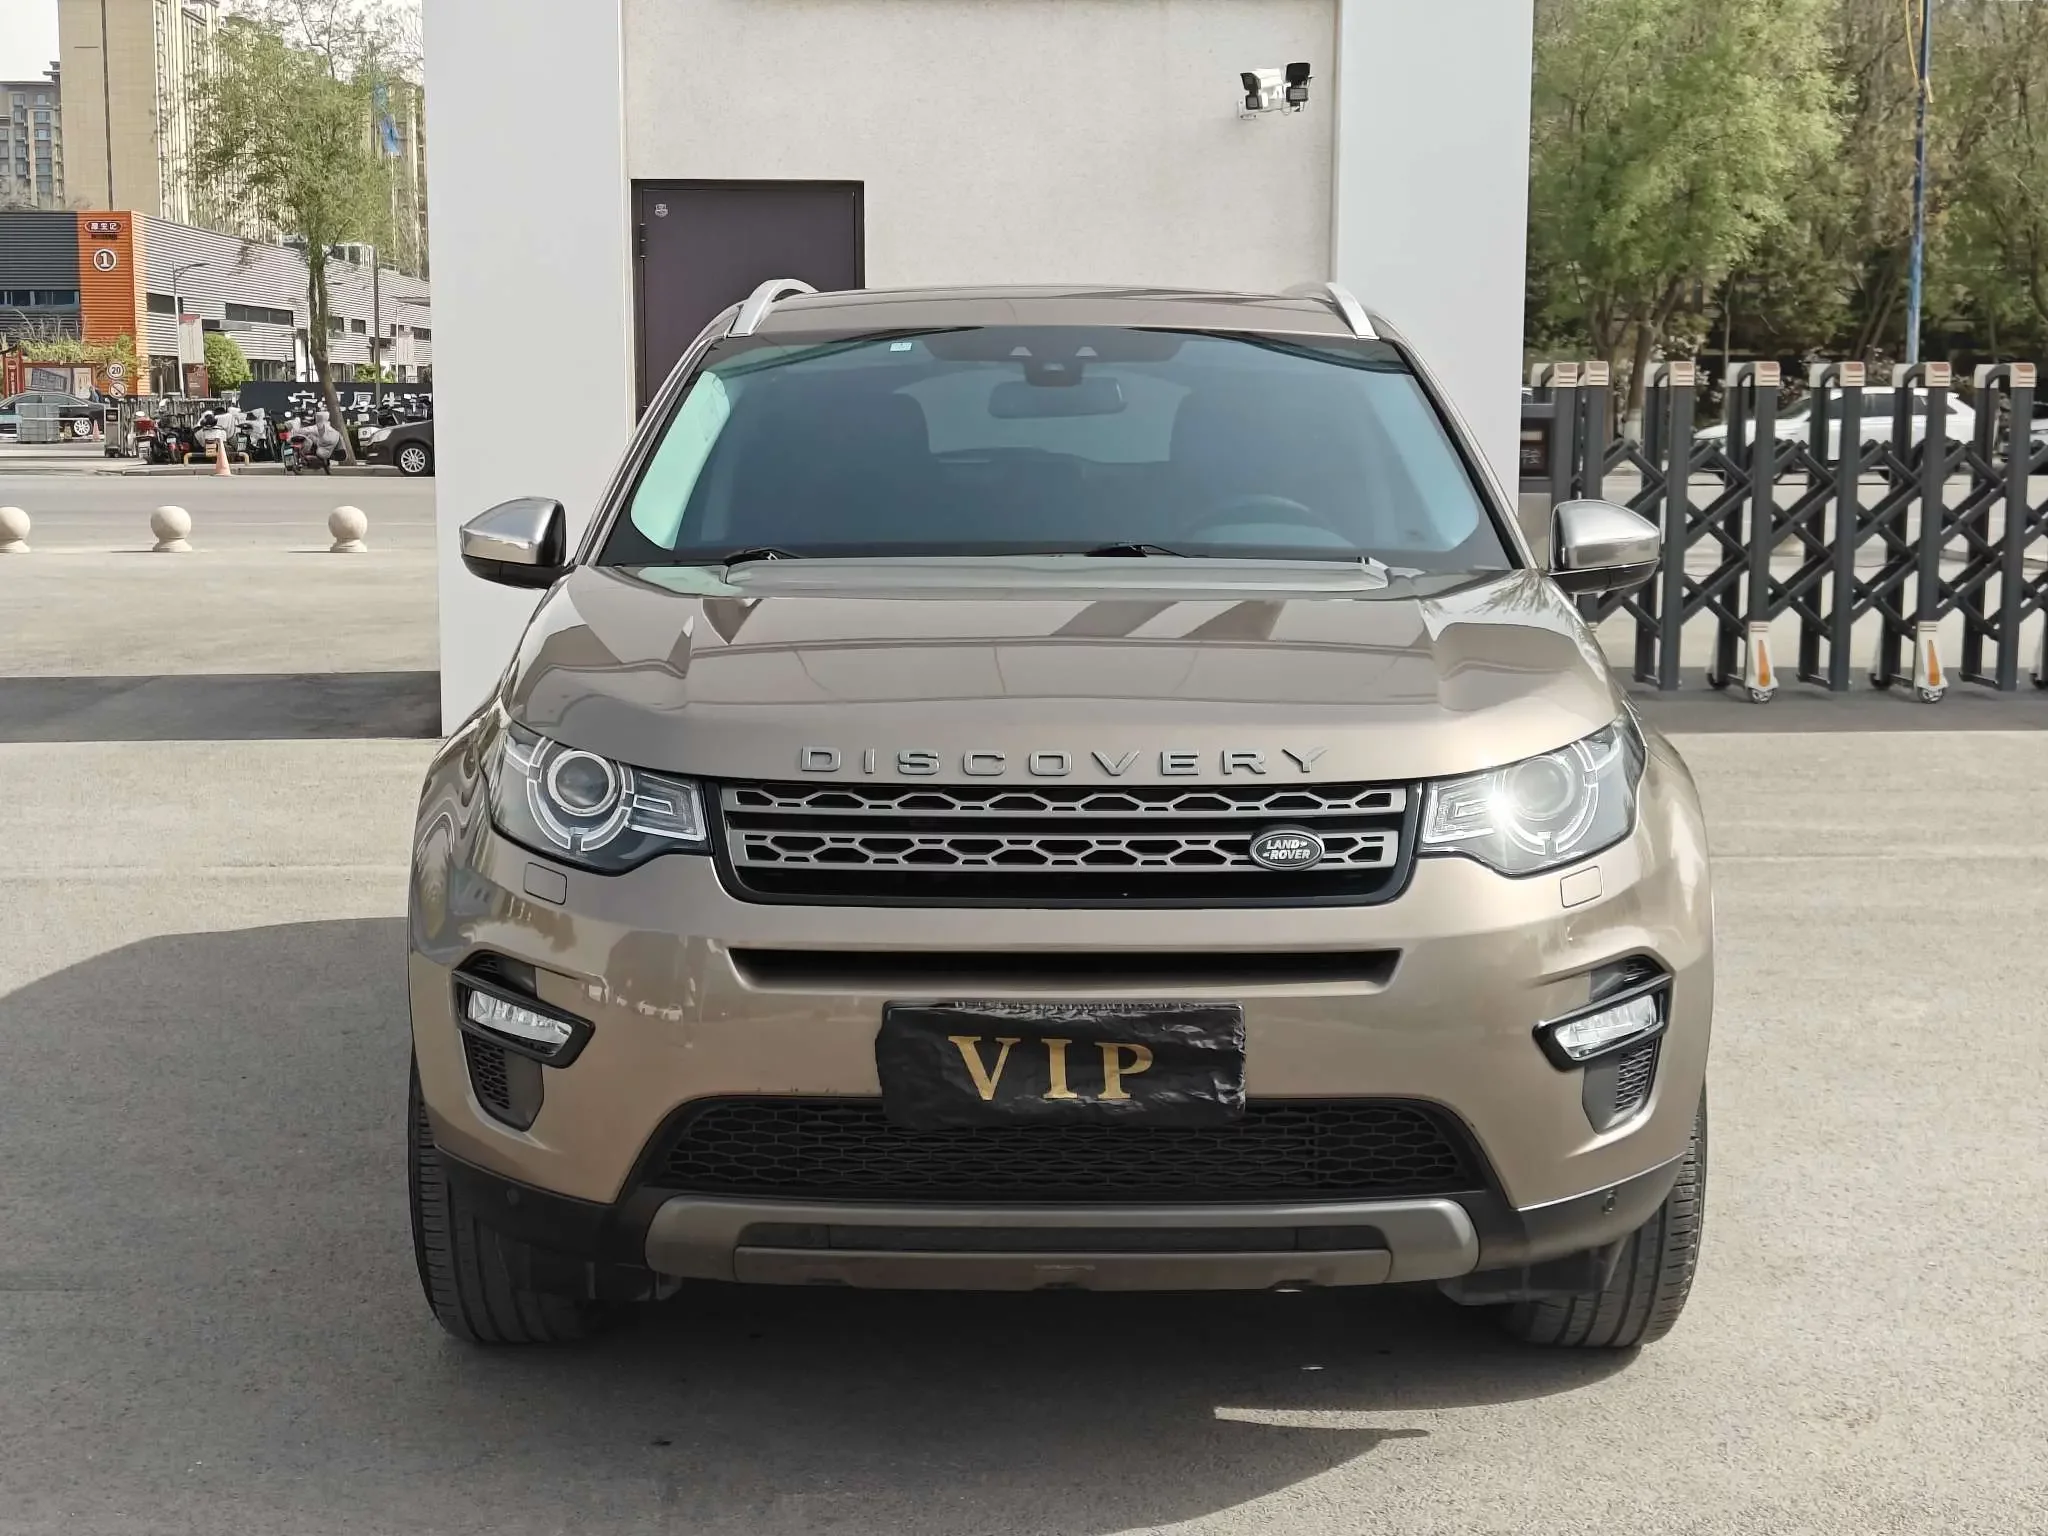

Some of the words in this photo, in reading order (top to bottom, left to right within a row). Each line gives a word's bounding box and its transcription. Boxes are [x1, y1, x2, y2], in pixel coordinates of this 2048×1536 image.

[111, 366, 121, 375] 20
[801, 746, 1327, 776] DISCOVERY
[1266, 839, 1300, 850] LAND
[1269, 849, 1311, 859] ROVER
[948, 1035, 1154, 1101] VIP
